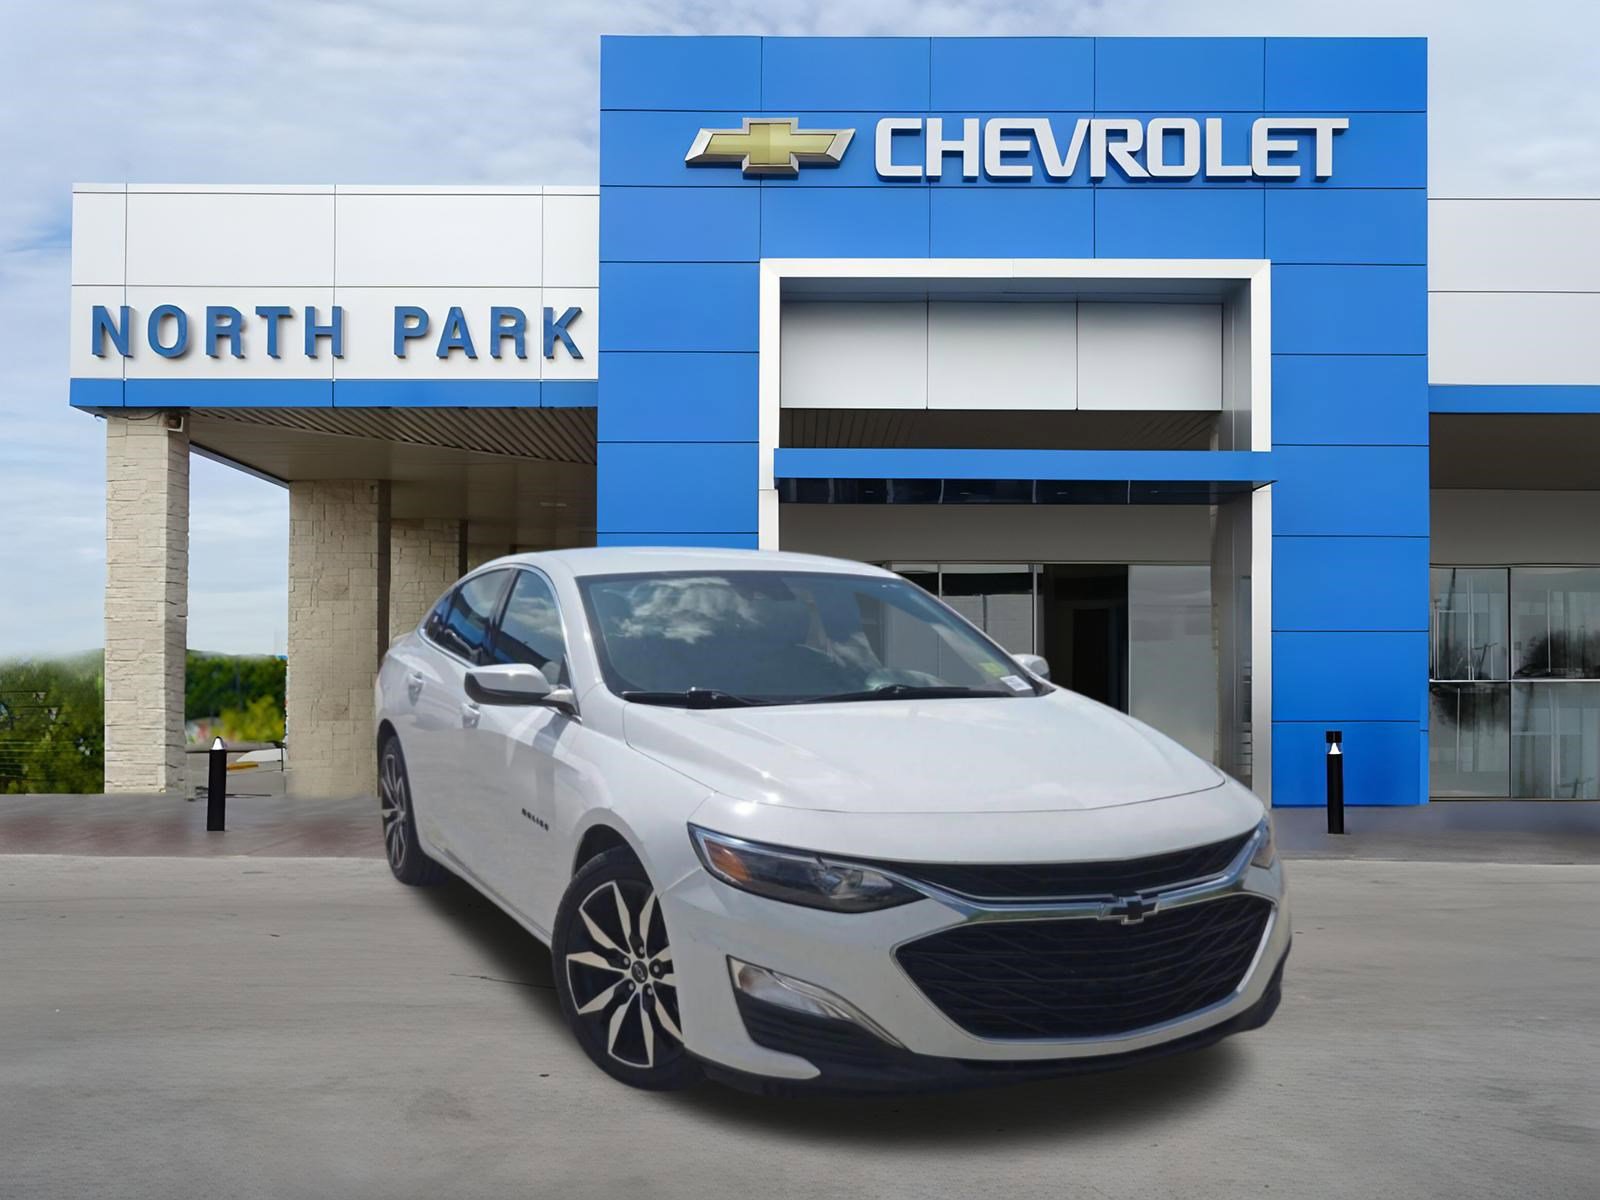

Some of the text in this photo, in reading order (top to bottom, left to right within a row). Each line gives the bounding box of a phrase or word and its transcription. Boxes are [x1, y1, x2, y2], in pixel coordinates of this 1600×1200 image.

[875, 117, 1350, 179] CHEVROLET
[91, 304, 584, 360] NORTH PARK
